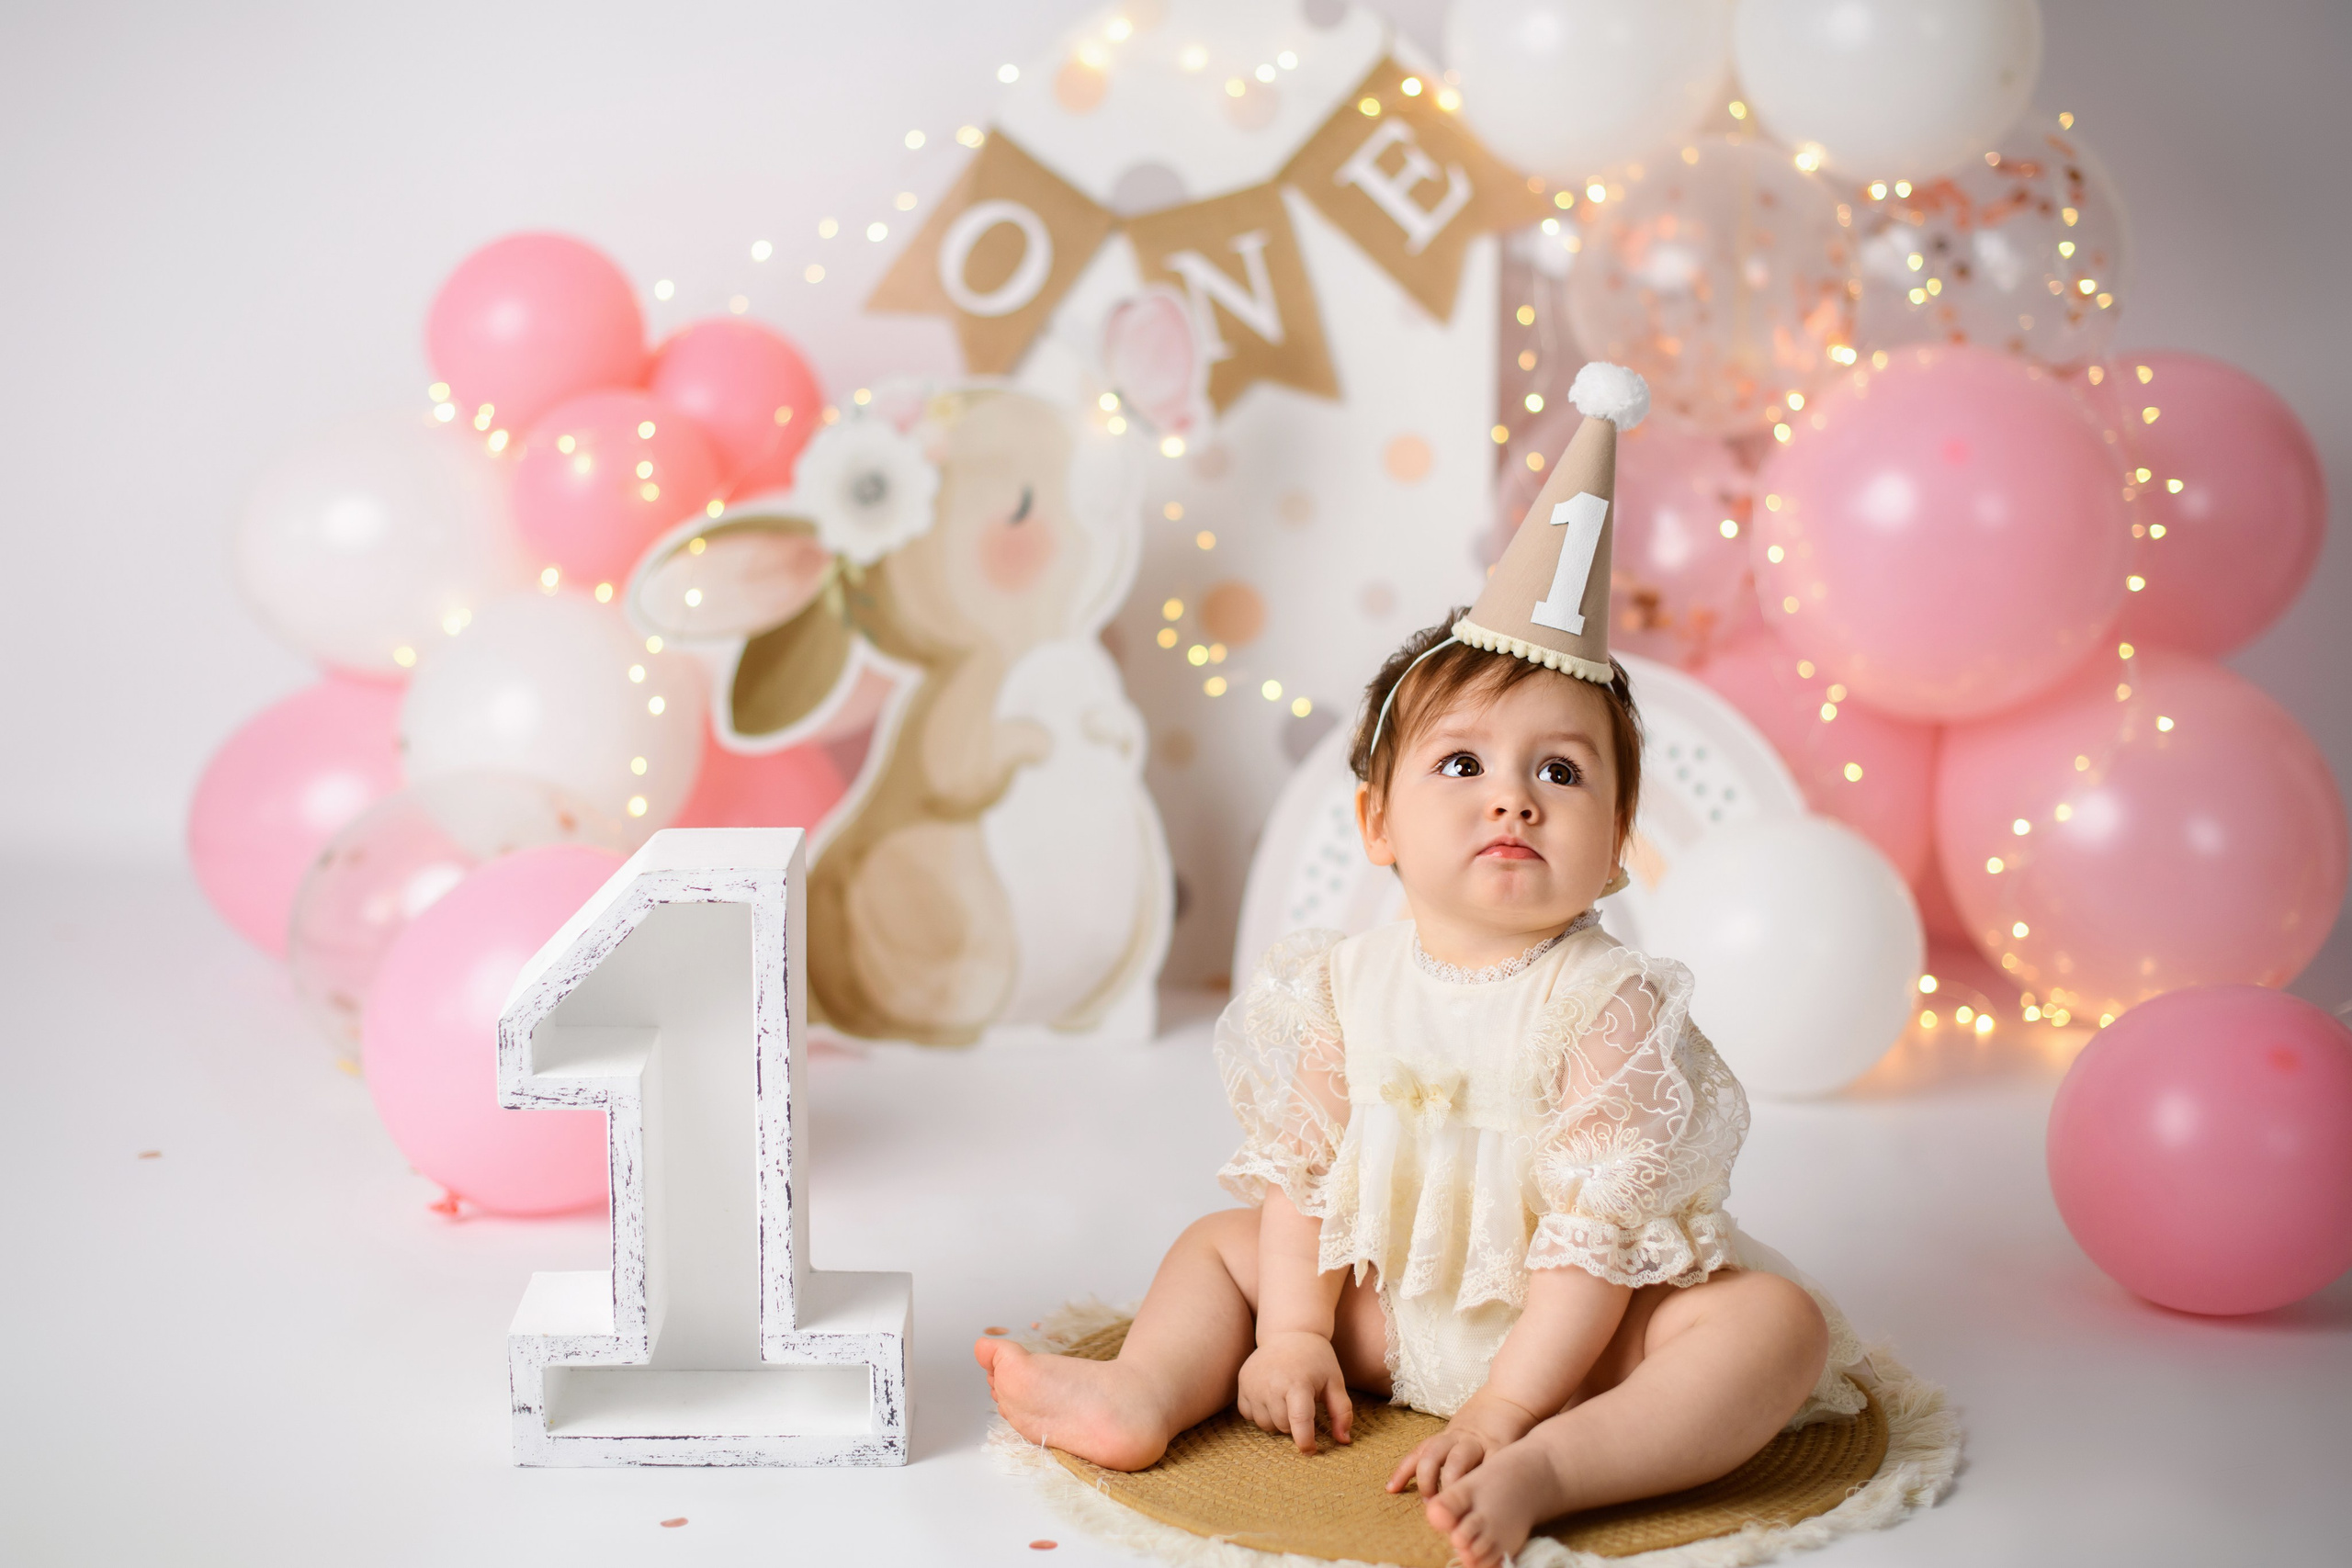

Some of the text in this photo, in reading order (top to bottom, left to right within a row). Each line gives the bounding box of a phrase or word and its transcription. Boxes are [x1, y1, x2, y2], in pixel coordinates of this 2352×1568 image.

[937, 117, 1473, 361] ONE
[1531, 491, 1609, 636] 1
[497, 828, 913, 1468] 1
